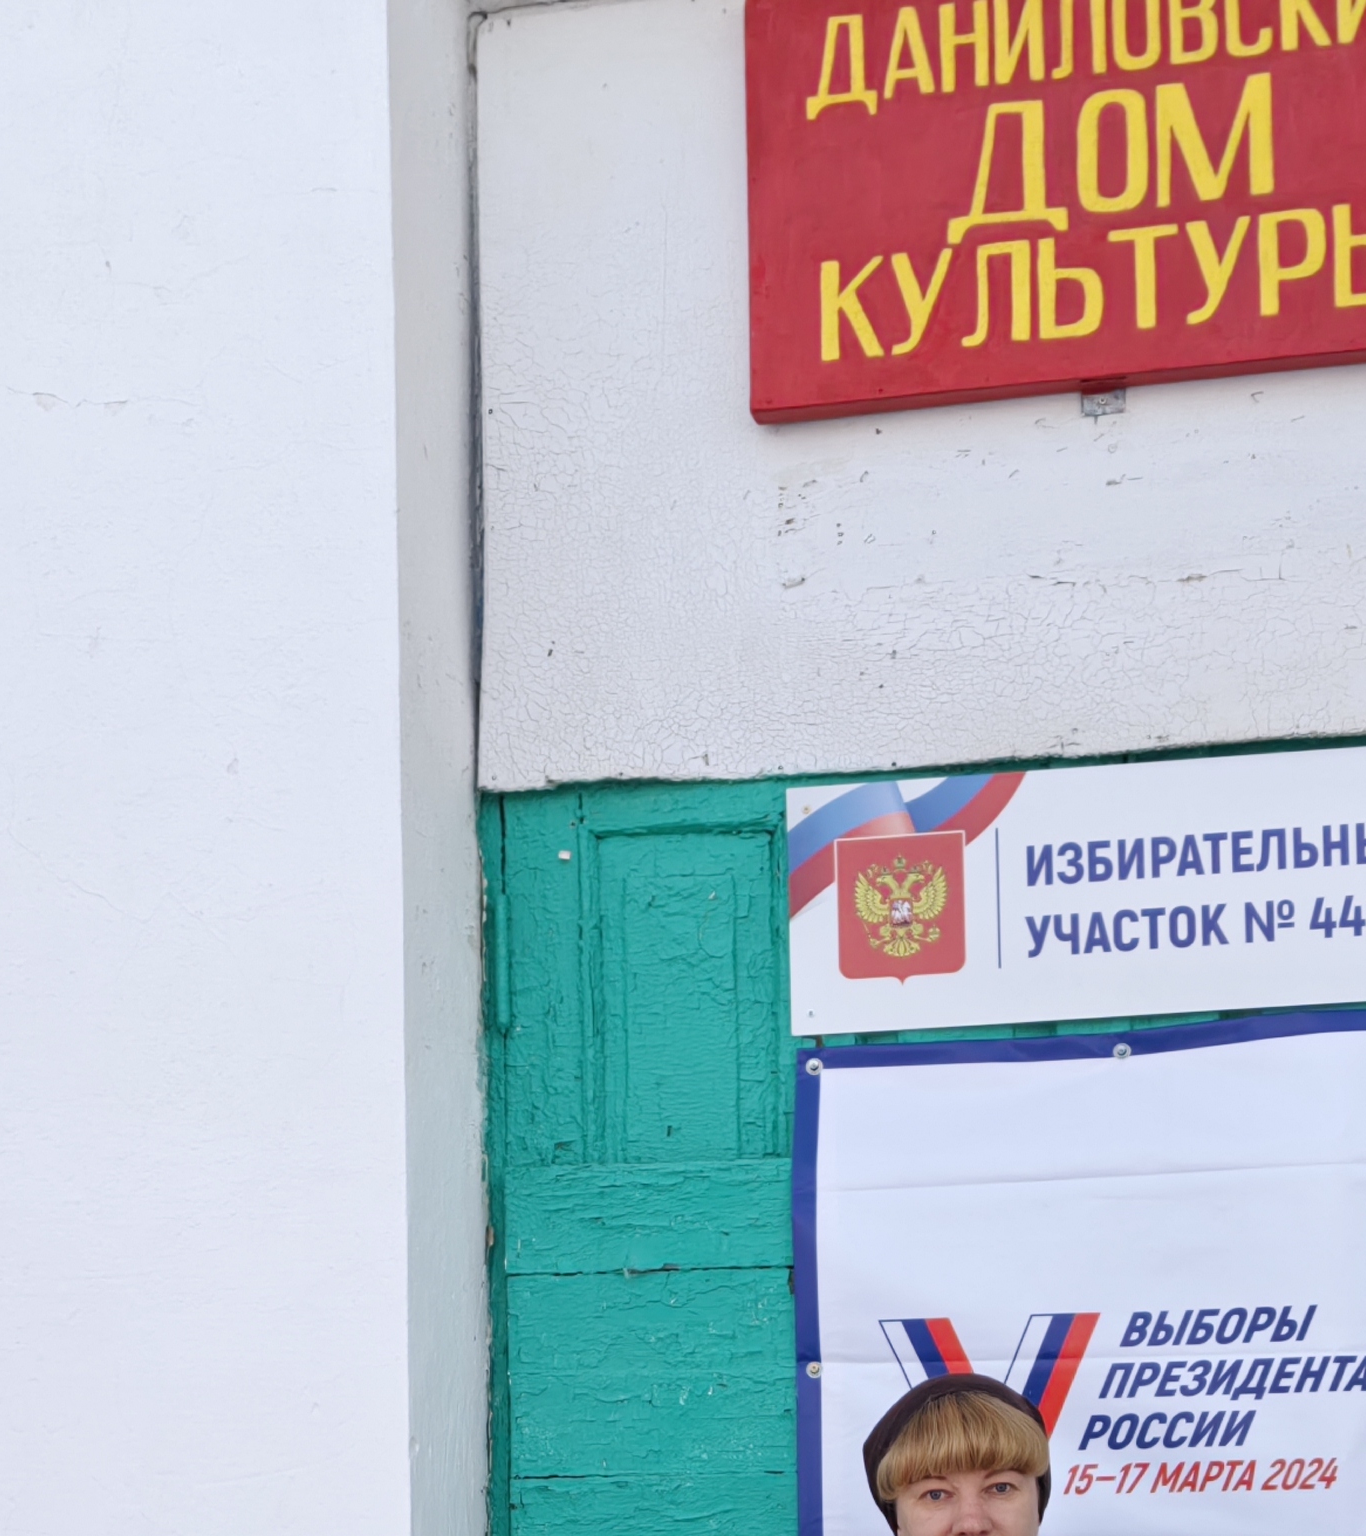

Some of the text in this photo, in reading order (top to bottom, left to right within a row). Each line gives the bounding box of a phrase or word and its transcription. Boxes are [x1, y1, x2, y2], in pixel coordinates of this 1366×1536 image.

[948, 73, 1277, 246] ДОМ
[1025, 904, 1231, 959] УЧАСТОК
[1244, 900, 1297, 945] №
[1119, 1304, 1319, 1349] ВЫБОРЫ
[1077, 1409, 1258, 1452] РОССИИ
[1150, 1460, 1256, 1494] МАРТА
[1260, 1458, 1339, 1492] 2024
